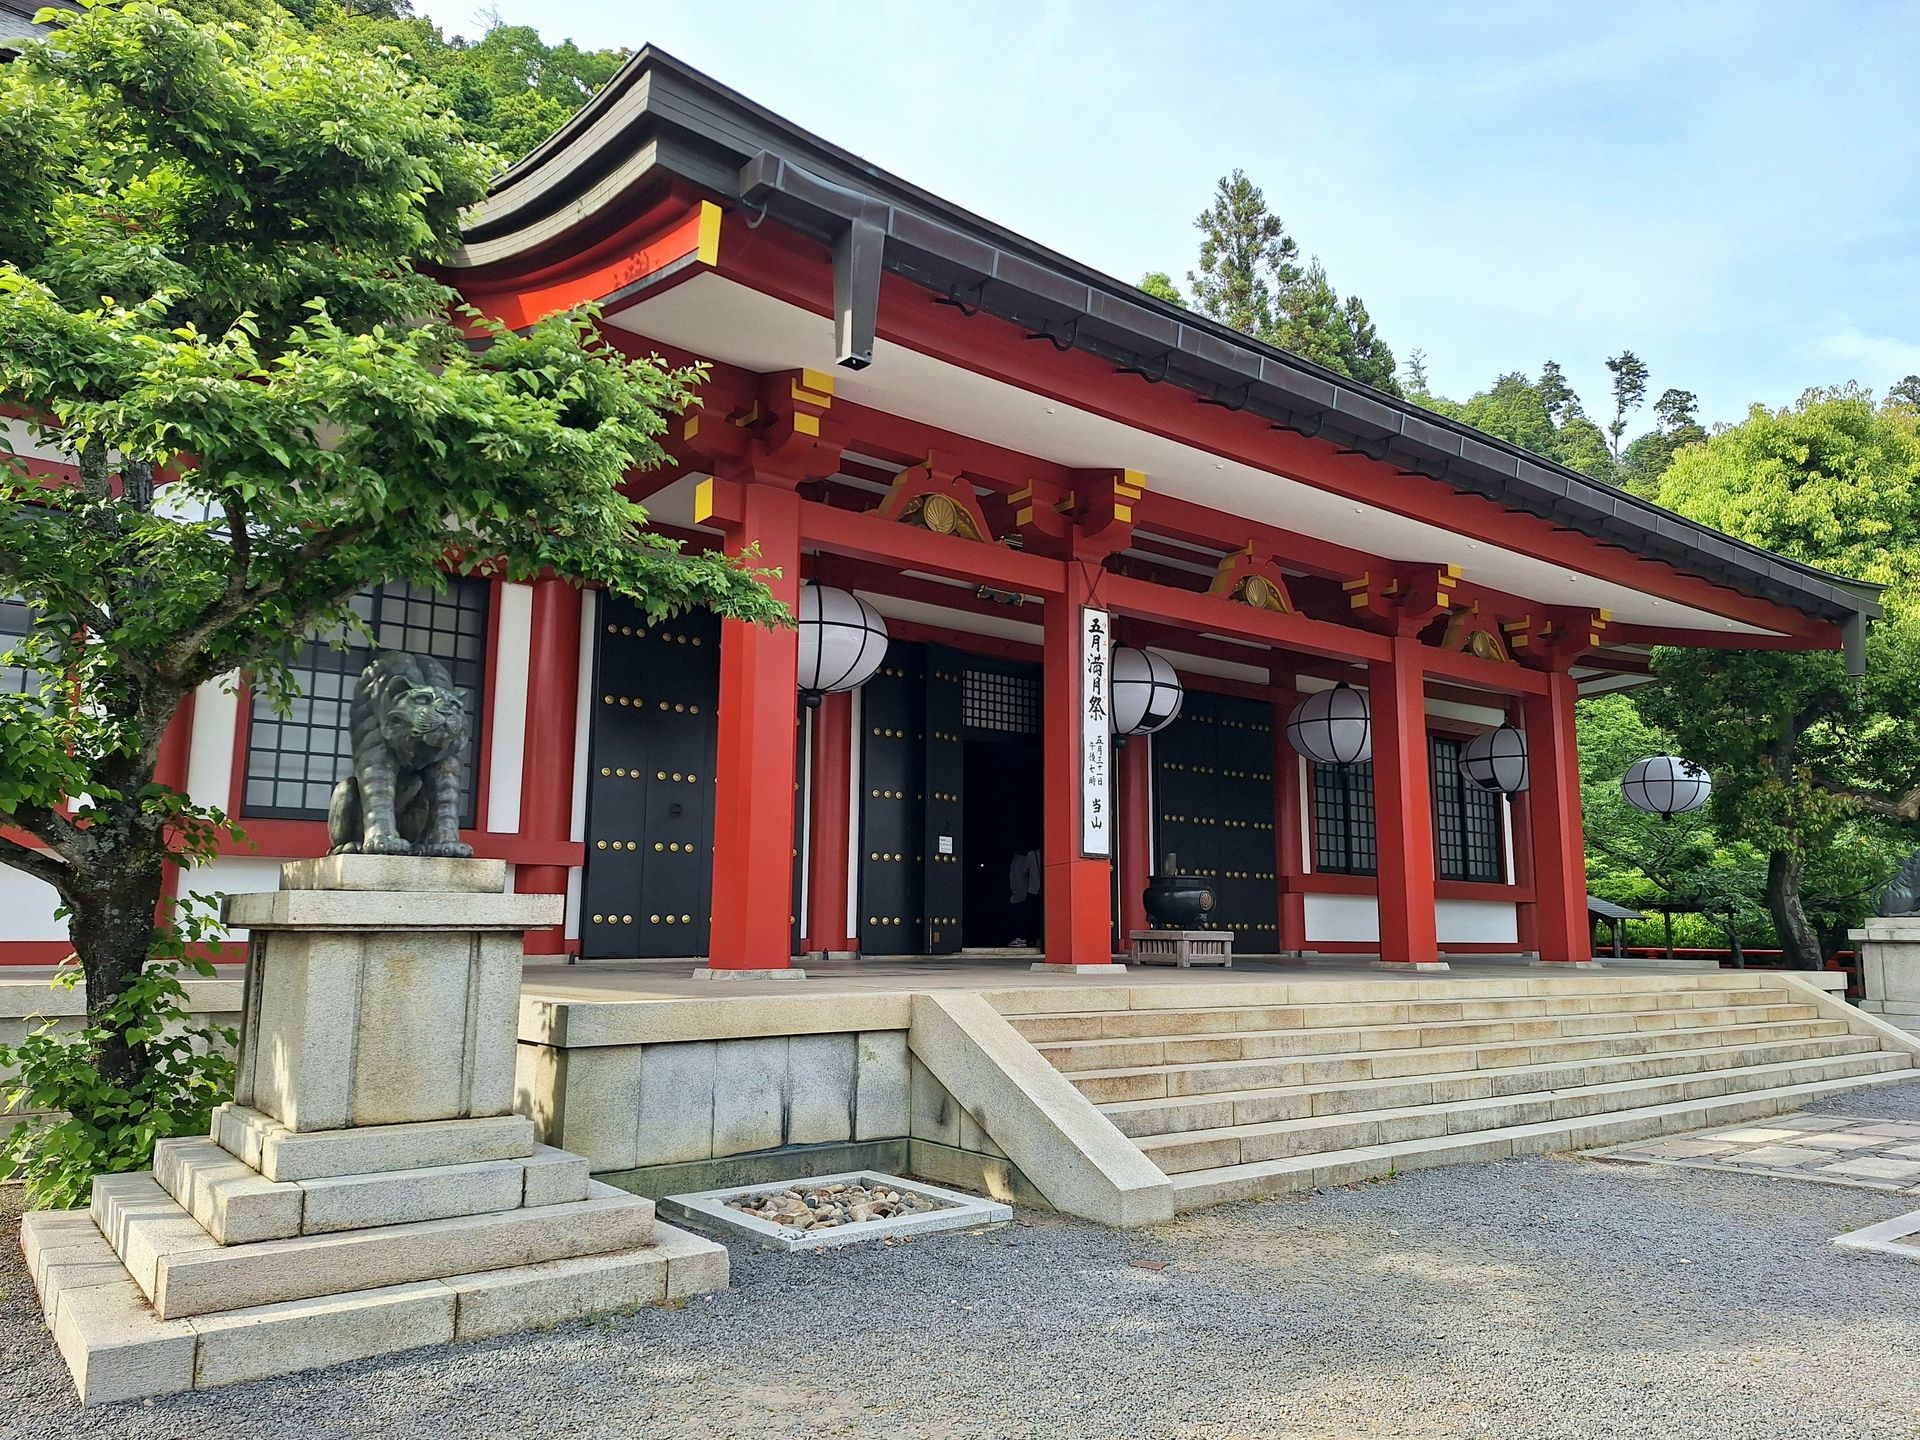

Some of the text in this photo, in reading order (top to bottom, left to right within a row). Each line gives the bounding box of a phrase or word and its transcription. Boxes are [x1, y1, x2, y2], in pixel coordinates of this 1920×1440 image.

[1087, 617, 1106, 721] 五月満月祭
[1095, 735, 1104, 787] 五月三十一日
[1091, 797, 1102, 829] 当山
